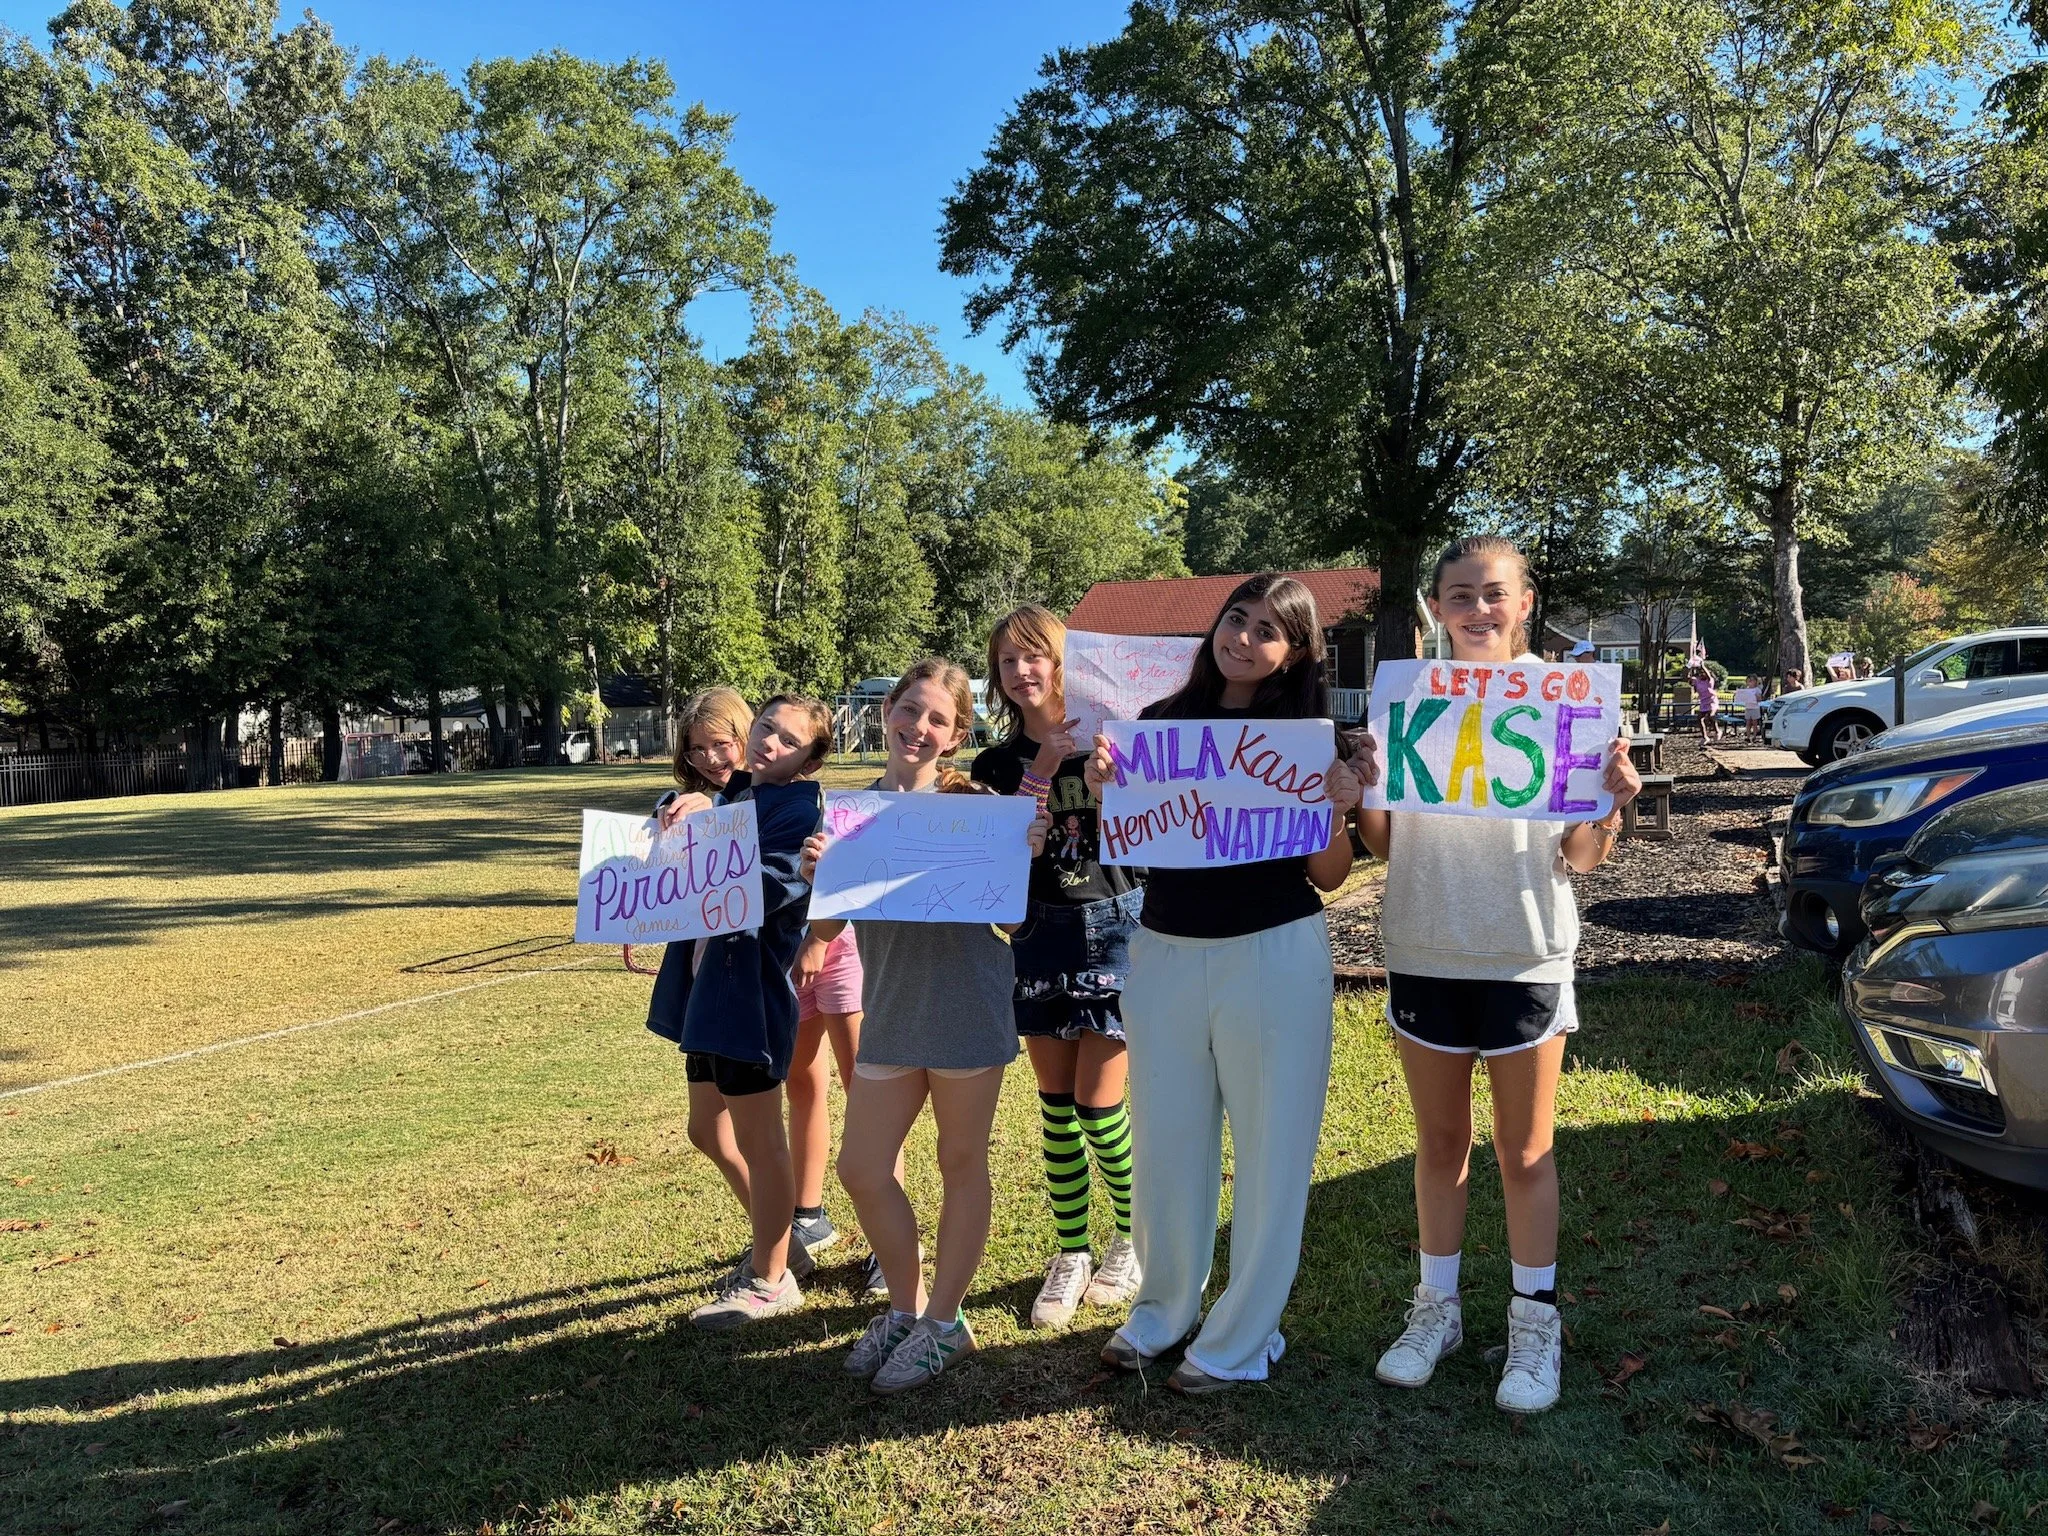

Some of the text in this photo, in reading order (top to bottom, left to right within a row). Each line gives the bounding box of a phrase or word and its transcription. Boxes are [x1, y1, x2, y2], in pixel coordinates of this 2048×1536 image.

[1430, 667, 1529, 699] LET'S
[1109, 724, 1327, 804] MILA Kase
[1386, 697, 1603, 815] KASE
[1102, 788, 1332, 861] Henry NATHAN
[587, 823, 757, 932] Pirates
[701, 884, 749, 931] GO
[626, 915, 691, 942] James
